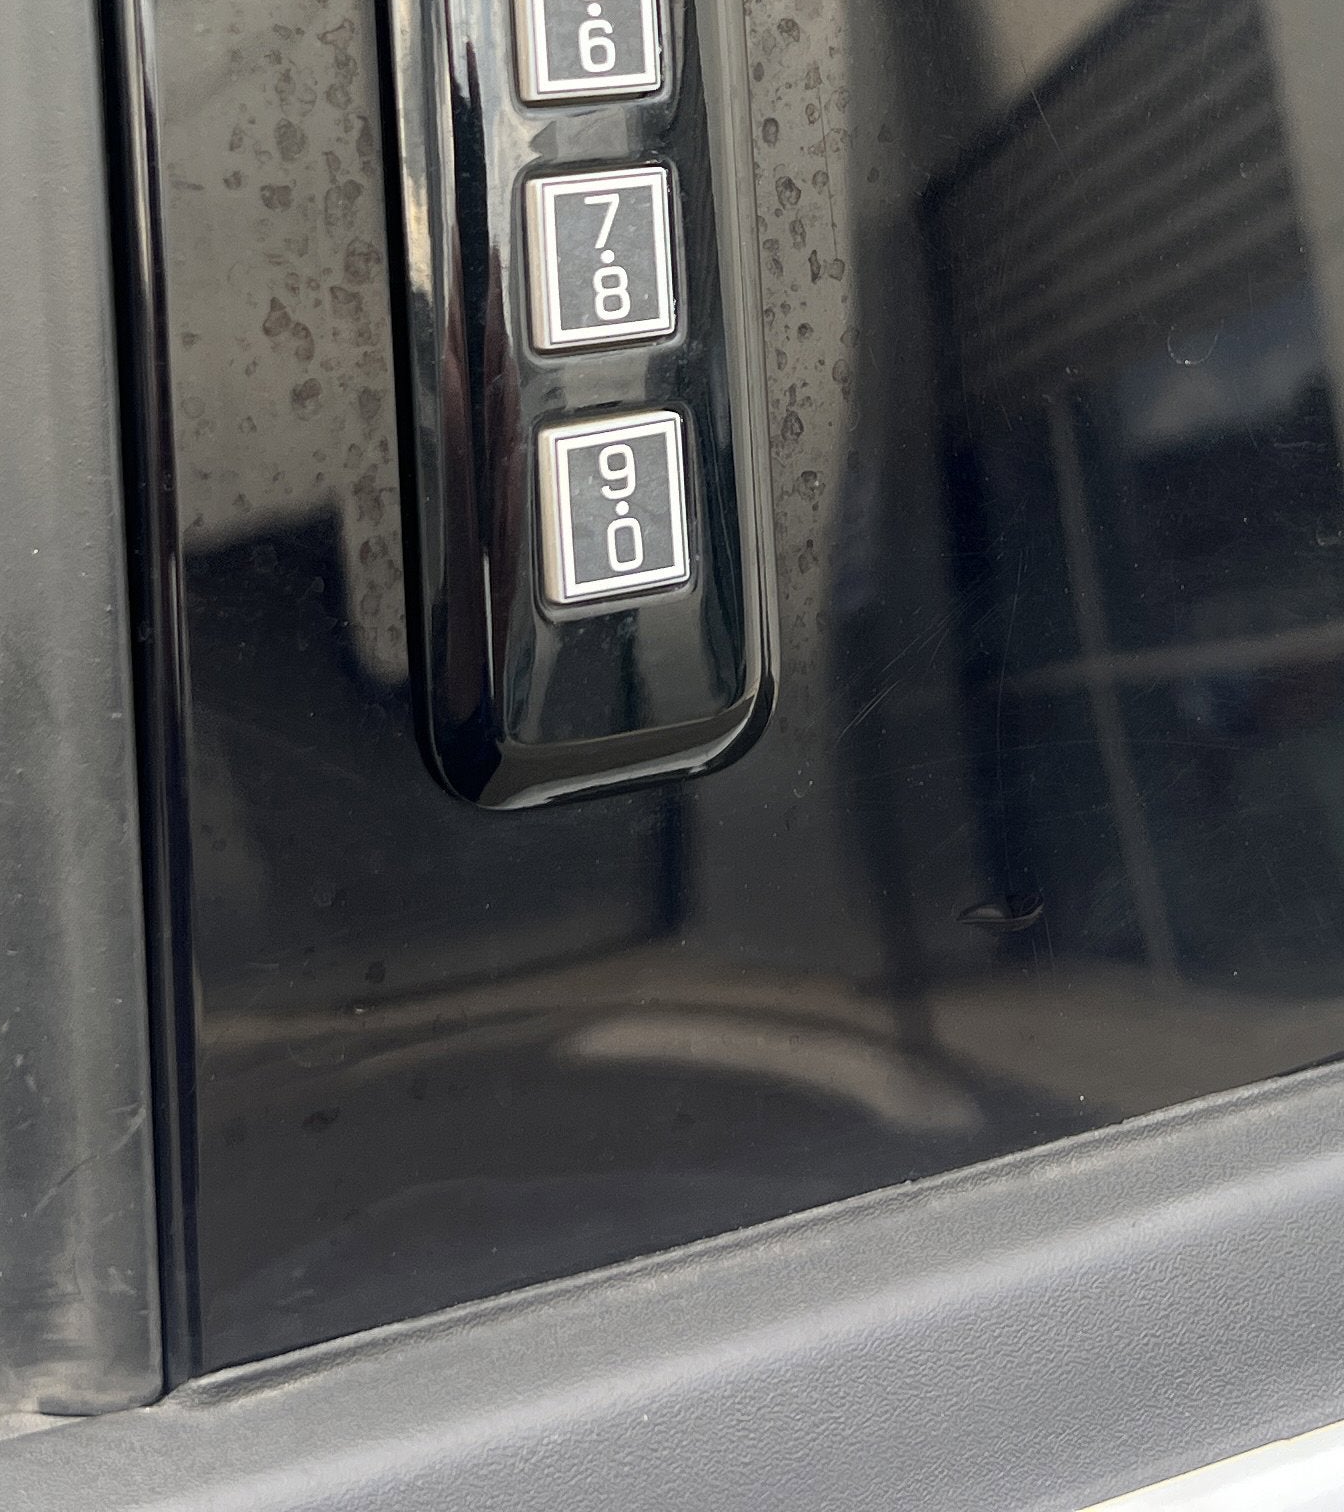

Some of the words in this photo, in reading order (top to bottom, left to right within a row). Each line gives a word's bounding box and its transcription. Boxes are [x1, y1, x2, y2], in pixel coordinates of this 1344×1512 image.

[578, 19, 616, 73] 6
[583, 193, 620, 250] 7
[593, 265, 631, 321] 8
[598, 444, 637, 500] 9
[607, 516, 644, 572] 0
